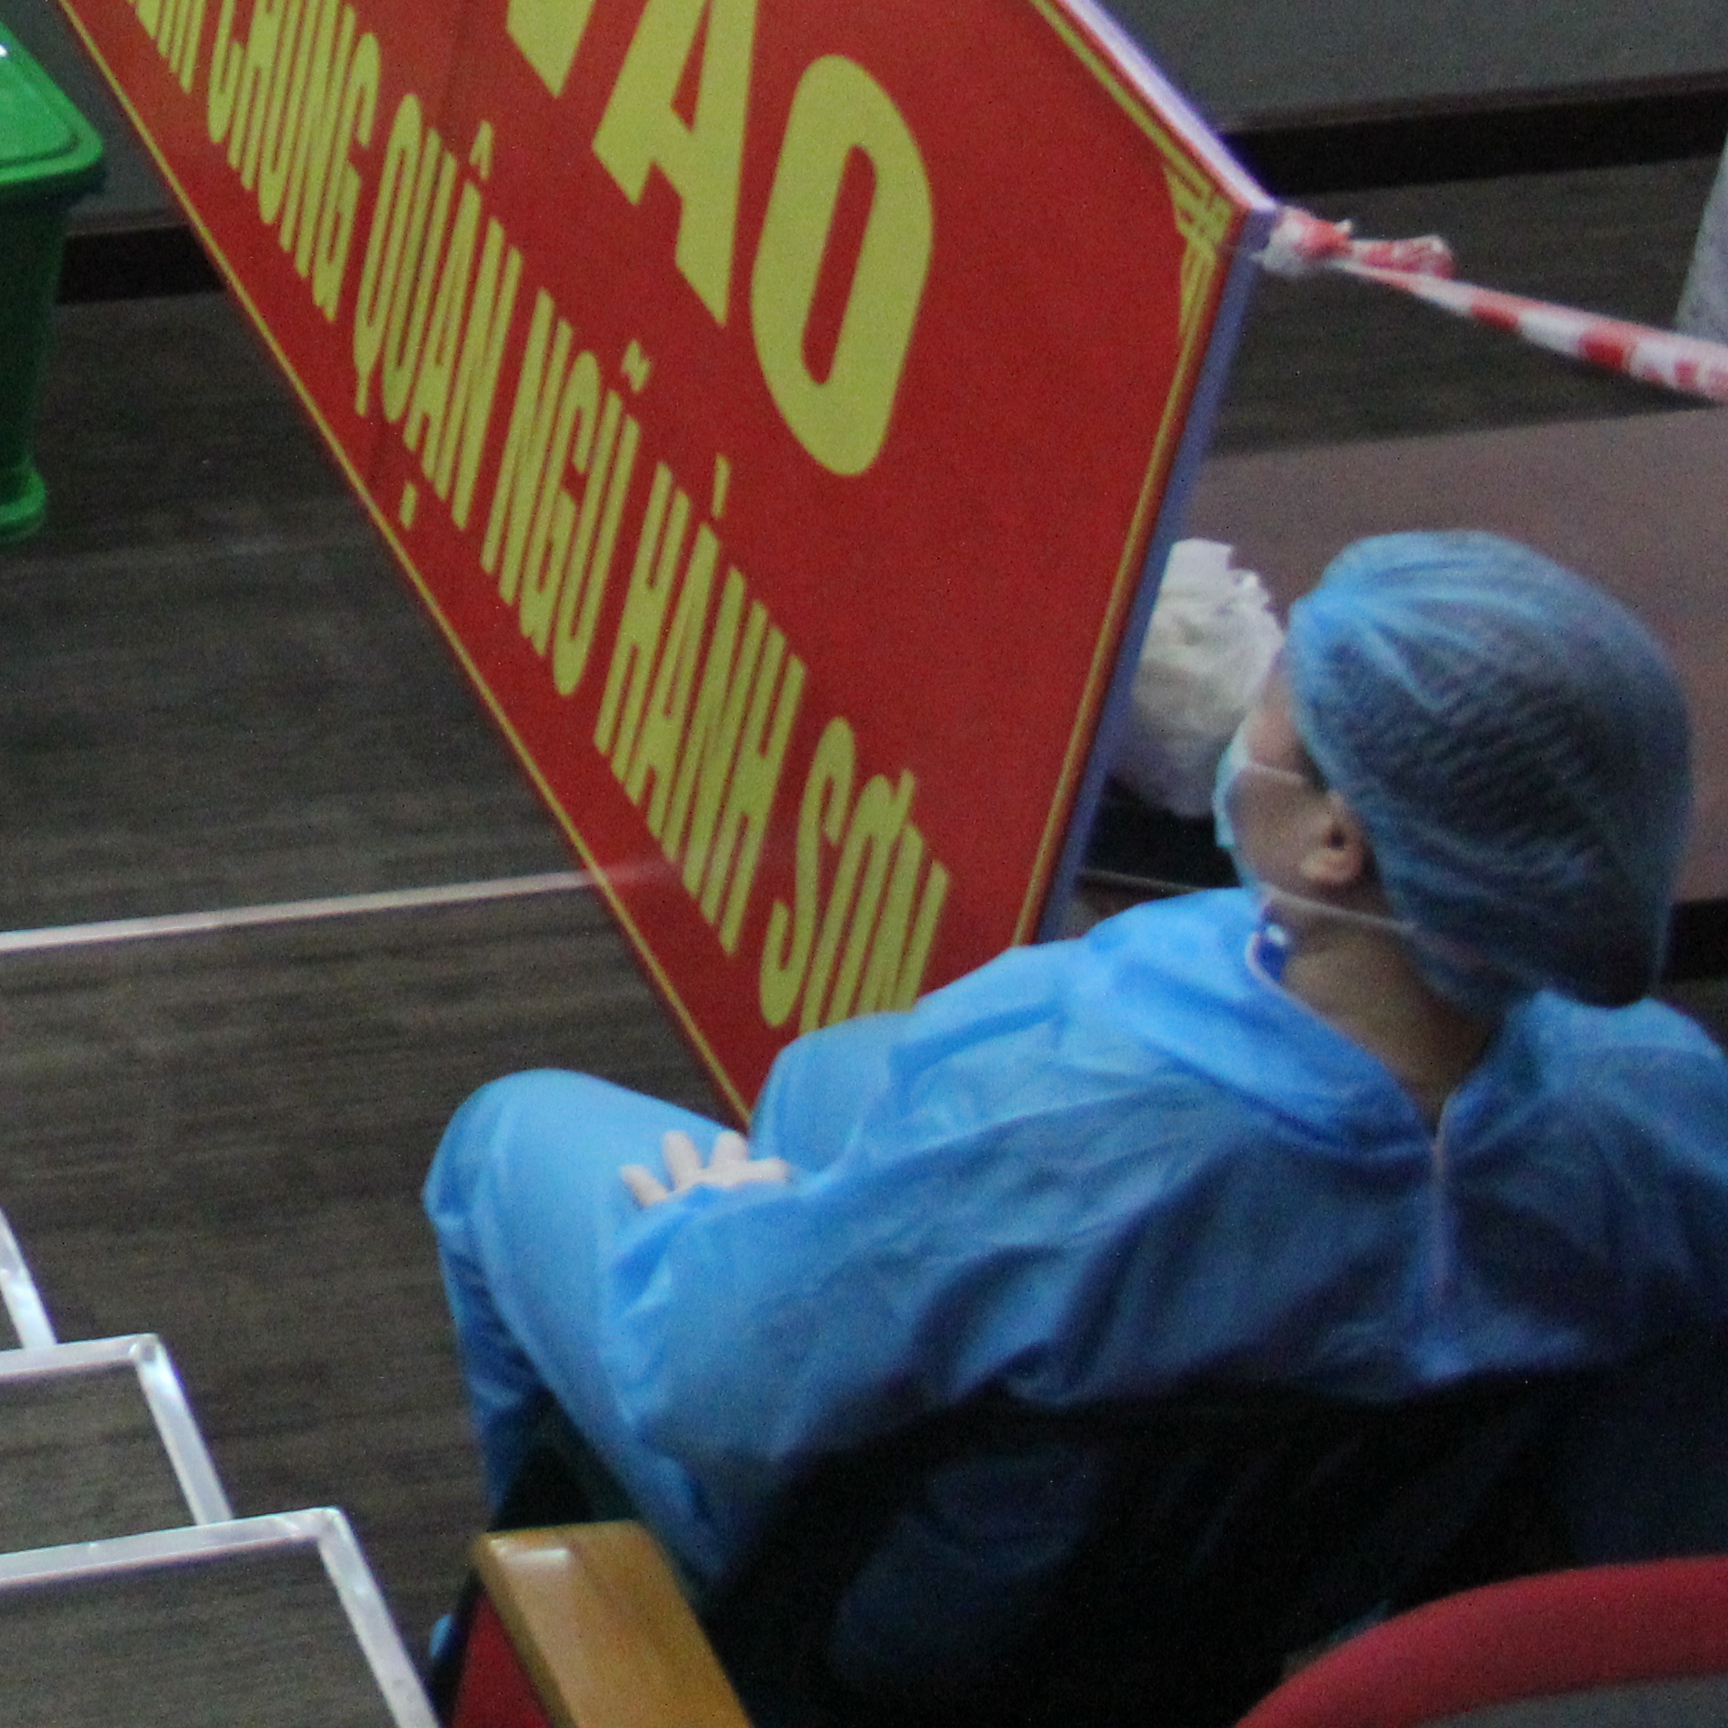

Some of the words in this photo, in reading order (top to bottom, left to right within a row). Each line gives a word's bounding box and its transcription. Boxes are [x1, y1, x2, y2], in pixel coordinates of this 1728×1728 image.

[354, 93, 522, 530] QUẬN
[481, 288, 651, 697] NGŨ
[594, 454, 806, 958] HÀNH
[758, 715, 951, 1034] SƠN
